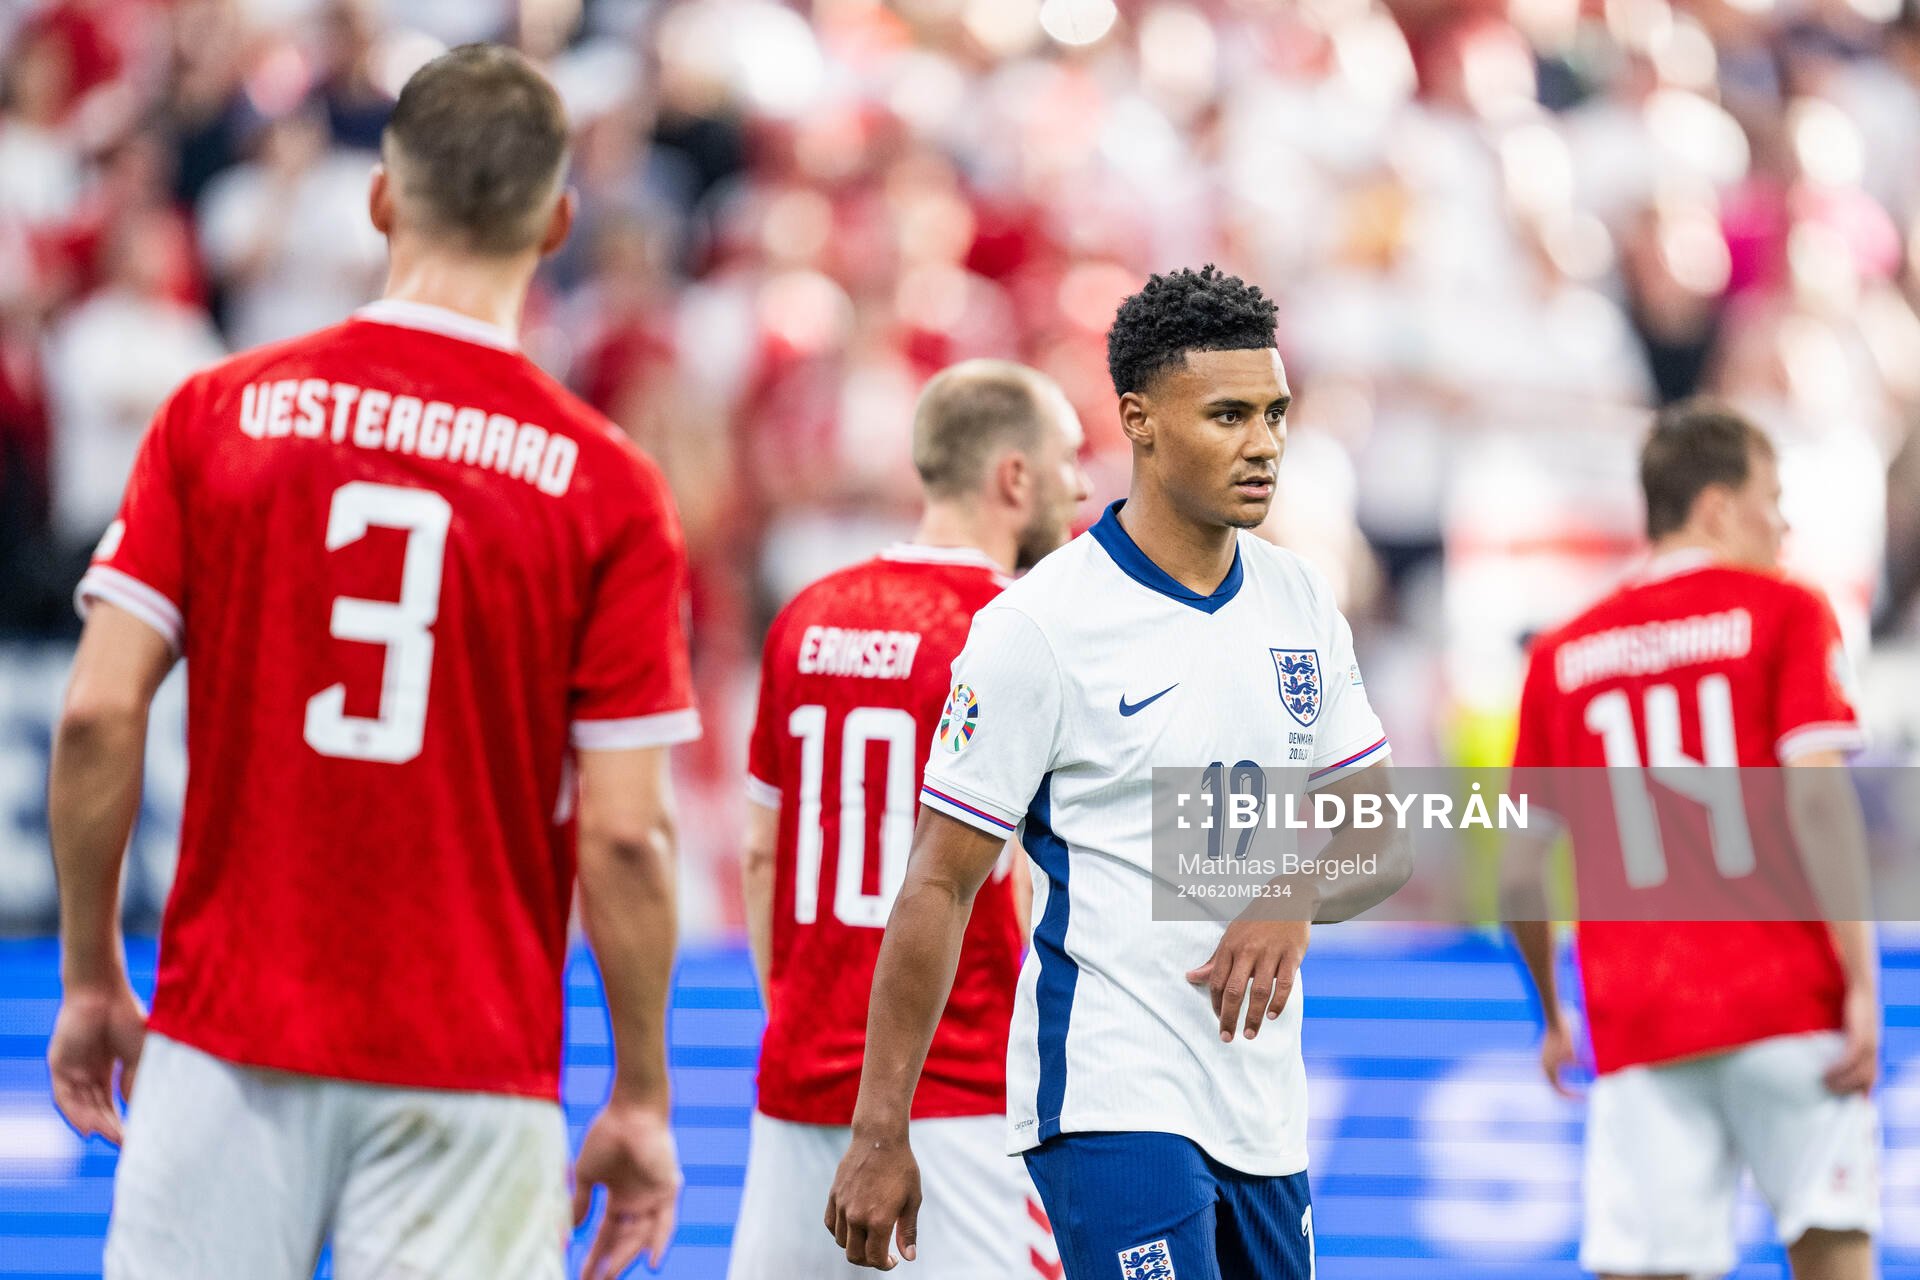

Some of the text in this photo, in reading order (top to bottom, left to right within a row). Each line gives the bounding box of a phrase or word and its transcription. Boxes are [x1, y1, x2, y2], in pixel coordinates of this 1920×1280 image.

[239, 378, 579, 498] VESTERGAARD
[303, 480, 453, 765] 3
[797, 625, 922, 680] ERIKSEN
[788, 704, 917, 929] 10
[1201, 760, 1267, 860] 19
[1583, 672, 1756, 890] 14
